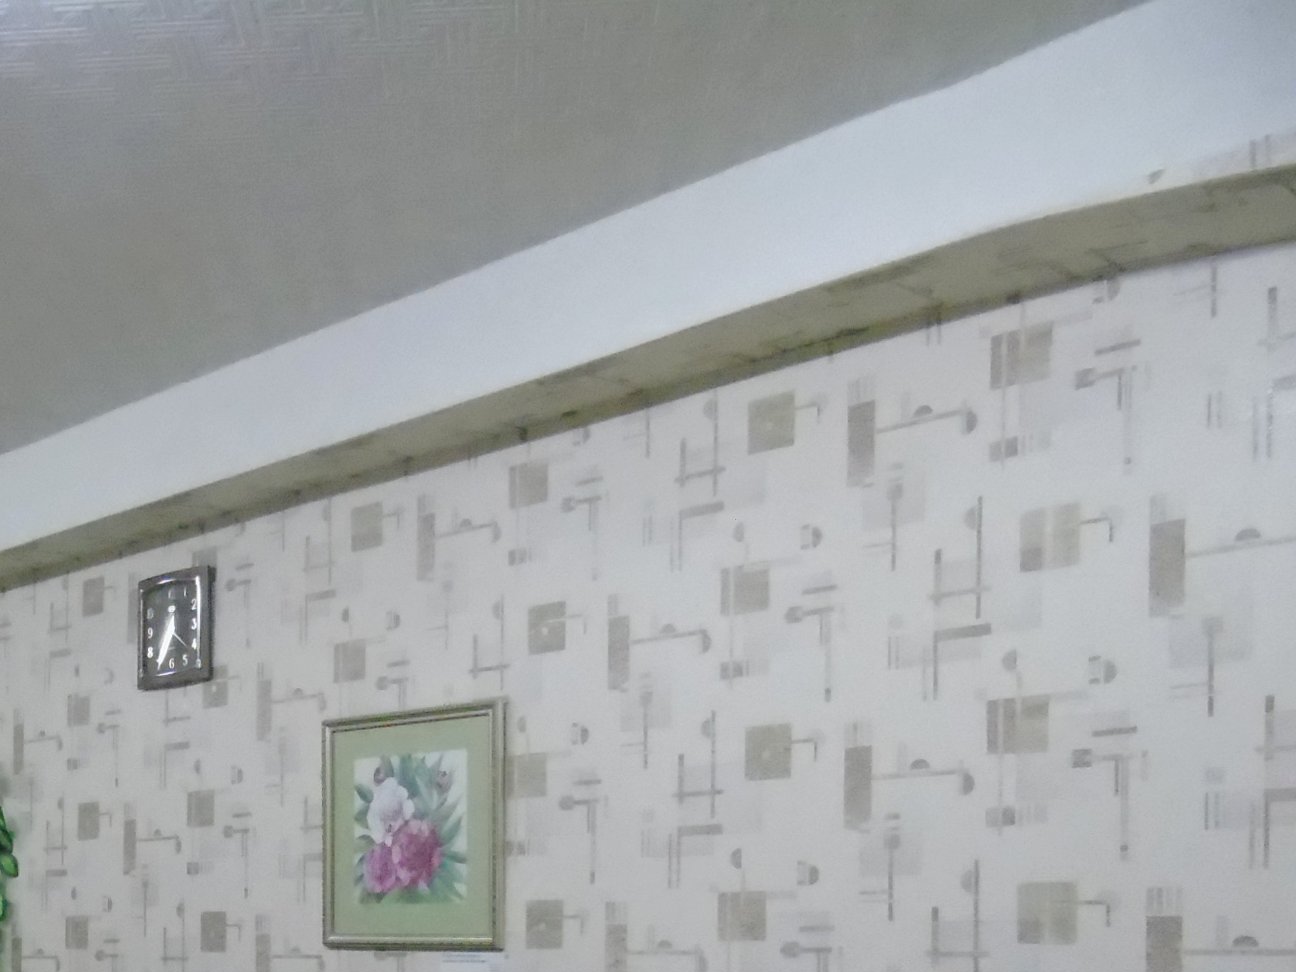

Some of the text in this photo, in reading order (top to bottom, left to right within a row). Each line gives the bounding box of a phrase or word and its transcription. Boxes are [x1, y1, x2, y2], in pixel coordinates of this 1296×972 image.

[190, 598, 197, 610] 2
[191, 618, 197, 630] 3
[147, 627, 153, 639] 9
[191, 638, 197, 650] 4
[147, 646, 154, 658] 8
[169, 657, 175, 669] 6
[182, 654, 188, 666] 5
